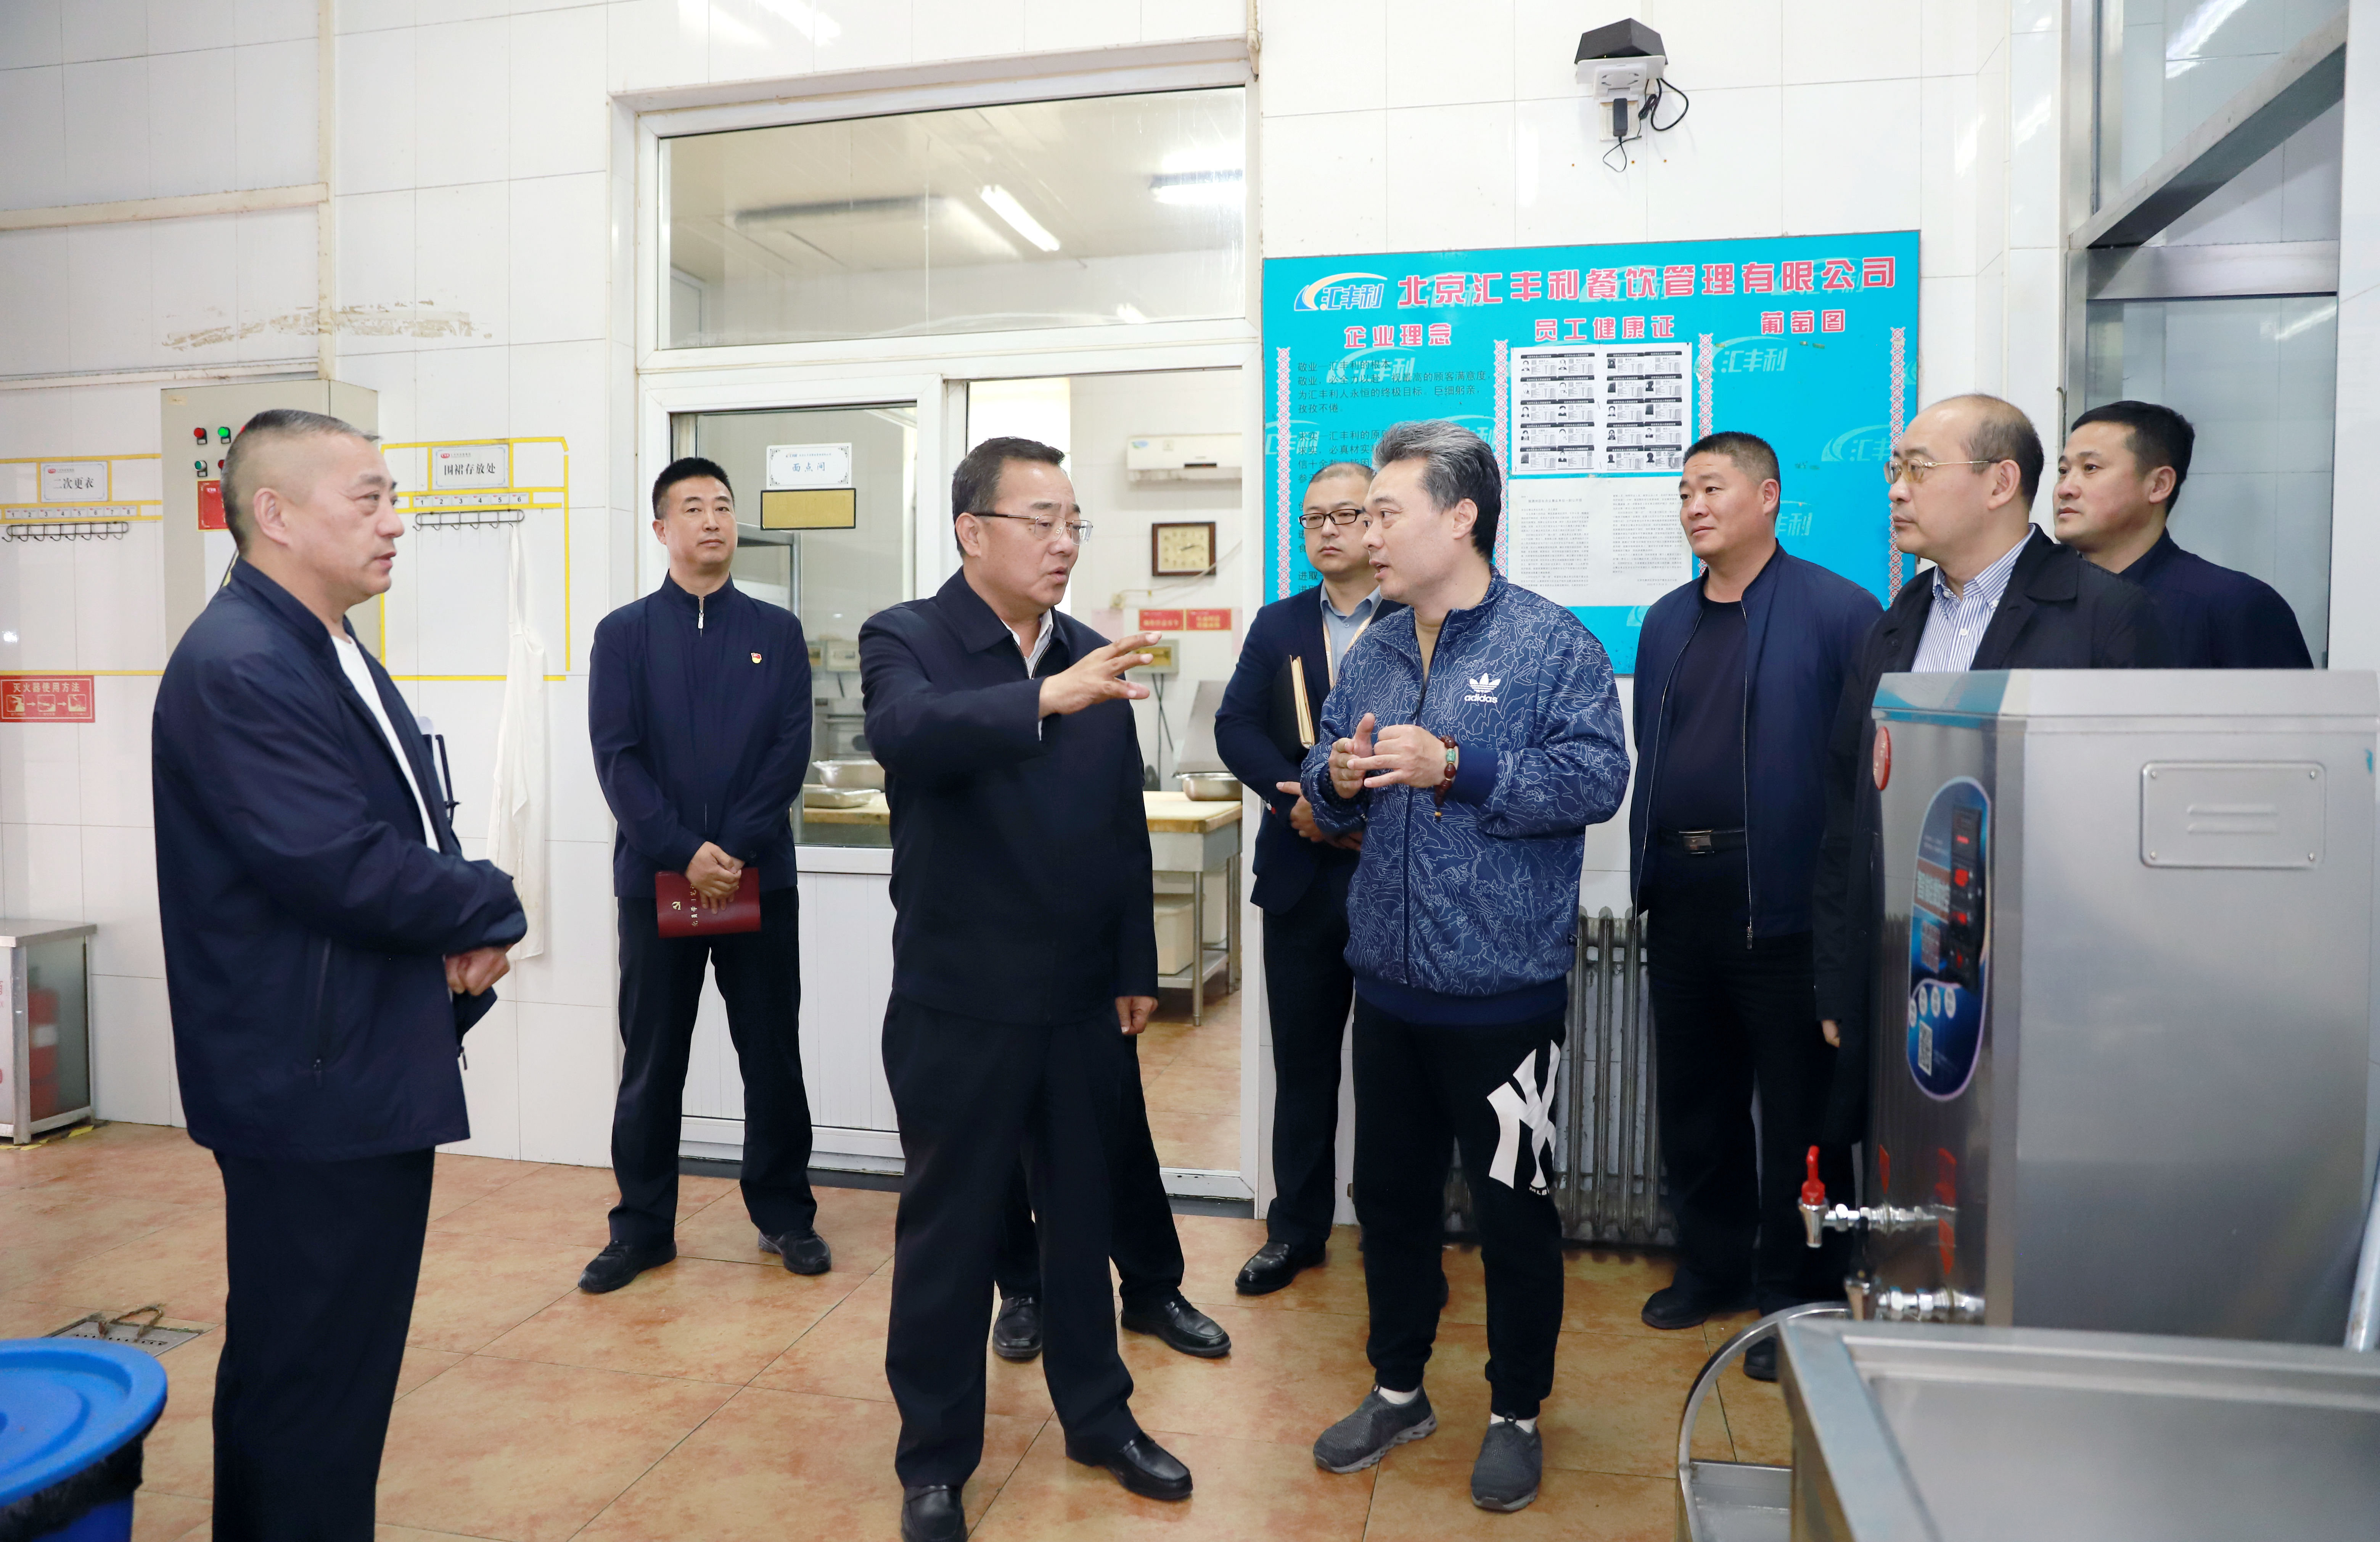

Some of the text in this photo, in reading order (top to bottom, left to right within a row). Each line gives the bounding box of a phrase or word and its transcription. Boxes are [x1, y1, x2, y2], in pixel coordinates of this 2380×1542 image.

[1398, 256, 1896, 306] 北京汇丰利餐饮管理有限公司
[1320, 283, 1384, 310] 汇丰利
[1534, 315, 1675, 341] 员工健康证
[1761, 309, 1845, 334] 葡萄图
[1344, 323, 1452, 349] 企业理念
[1721, 348, 1788, 373] 汇丰利
[444, 463, 496, 475] 围裙存放处
[792, 462, 825, 472] 面点间
[53, 477, 94, 489] 二次更衣
[13, 682, 80, 693] 灭火器使用方法
[1464, 693, 1498, 704] adidas
